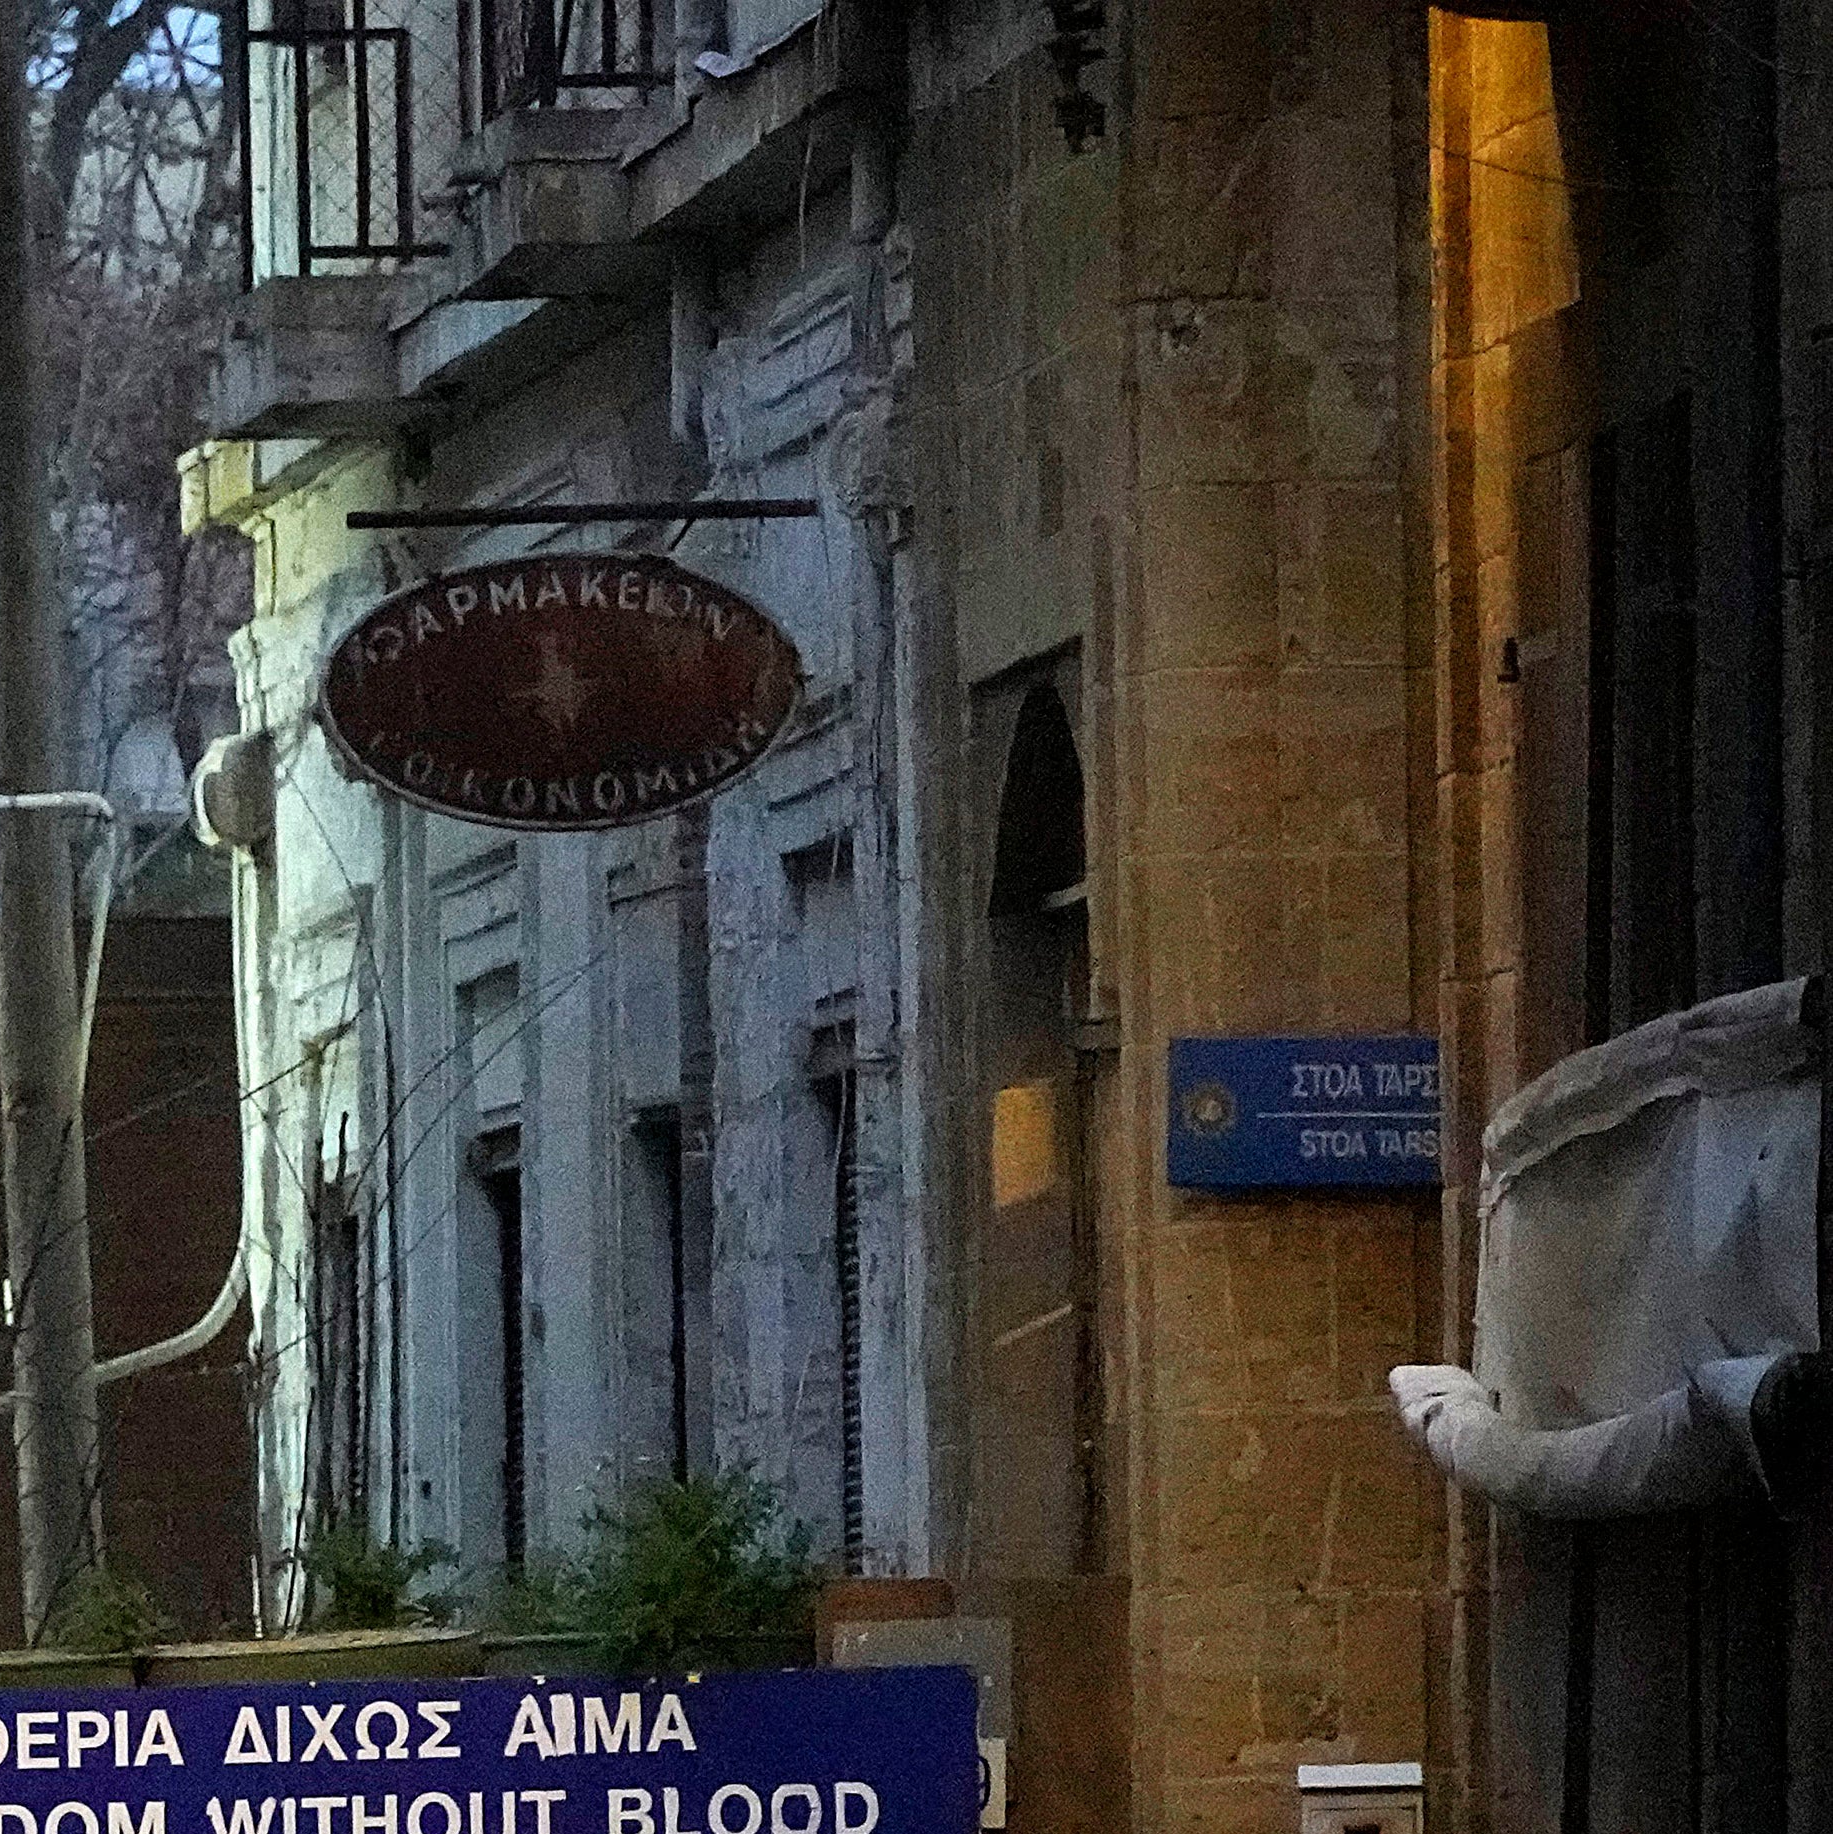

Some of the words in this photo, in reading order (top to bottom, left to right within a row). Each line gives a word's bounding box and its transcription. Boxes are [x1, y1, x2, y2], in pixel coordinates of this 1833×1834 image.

[1290, 1063, 1364, 1098] ΣΤΟΑ
[1299, 1129, 1368, 1159] STOA
[224, 1700, 462, 1765] ΔΙΧΩΣ
[504, 1692, 697, 1760] ΑΙΜΑ
